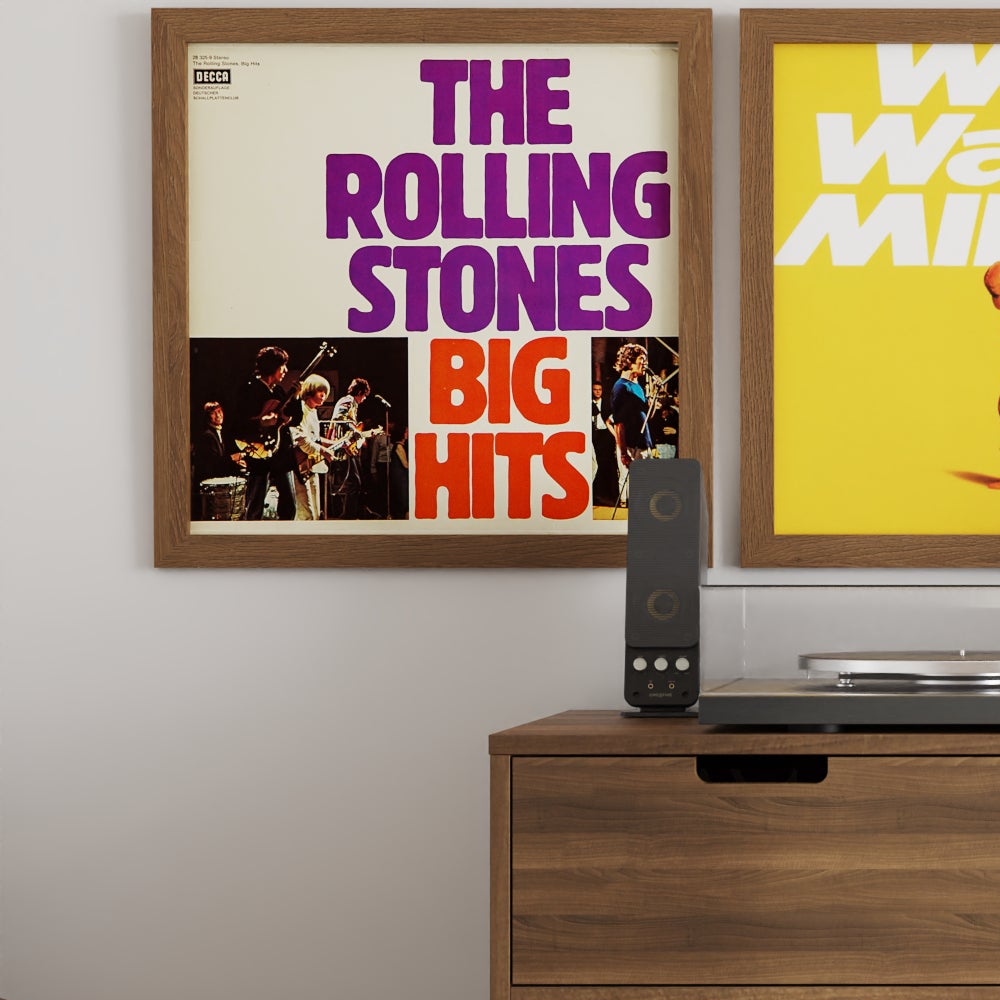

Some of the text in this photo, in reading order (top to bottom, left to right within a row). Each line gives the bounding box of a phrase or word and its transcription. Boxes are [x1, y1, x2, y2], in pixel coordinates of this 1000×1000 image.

[196, 71, 229, 82] DECCA
[420, 58, 573, 145] THE
[325, 151, 671, 239] ROLLING
[347, 244, 653, 333] STONES
[429, 337, 571, 425] BIG
[414, 432, 590, 520] HITS
